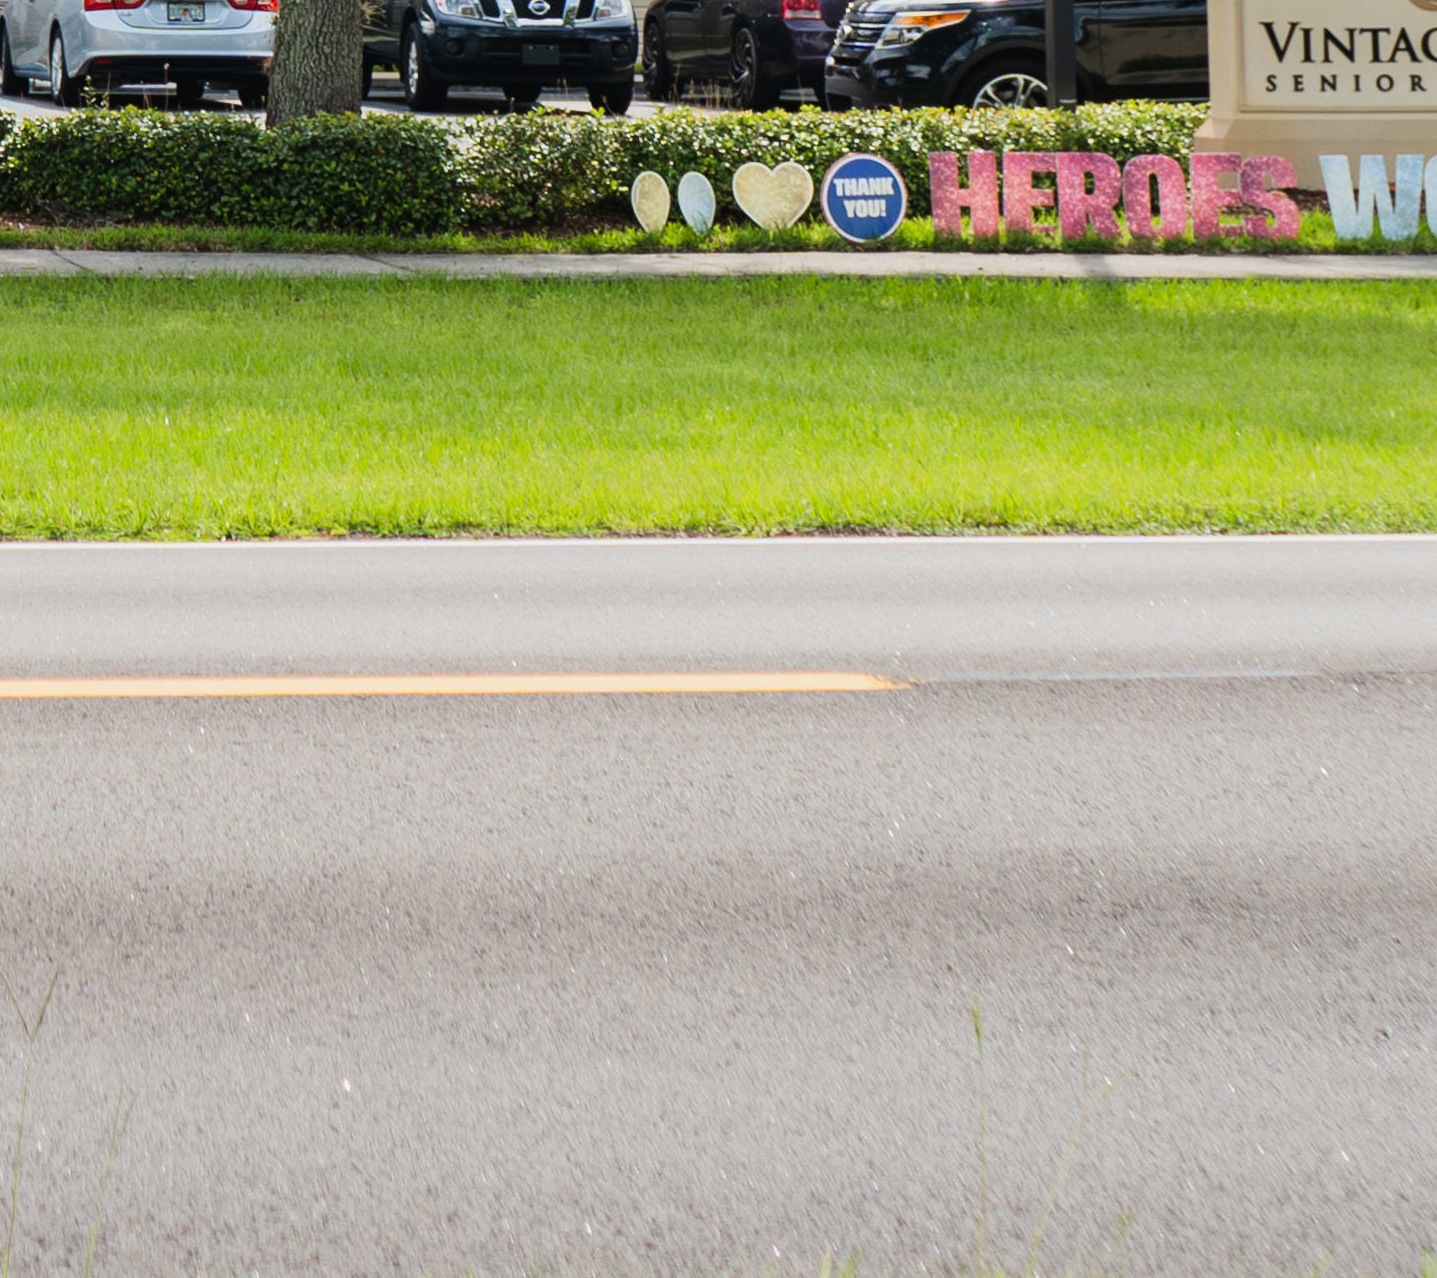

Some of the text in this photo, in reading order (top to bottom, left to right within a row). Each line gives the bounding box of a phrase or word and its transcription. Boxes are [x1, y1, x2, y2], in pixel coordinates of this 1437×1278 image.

[1265, 74, 1427, 92] SENIOR
[833, 177, 895, 196] THANK
[928, 151, 1301, 241] HEROES
[843, 199, 886, 218] YOU!
